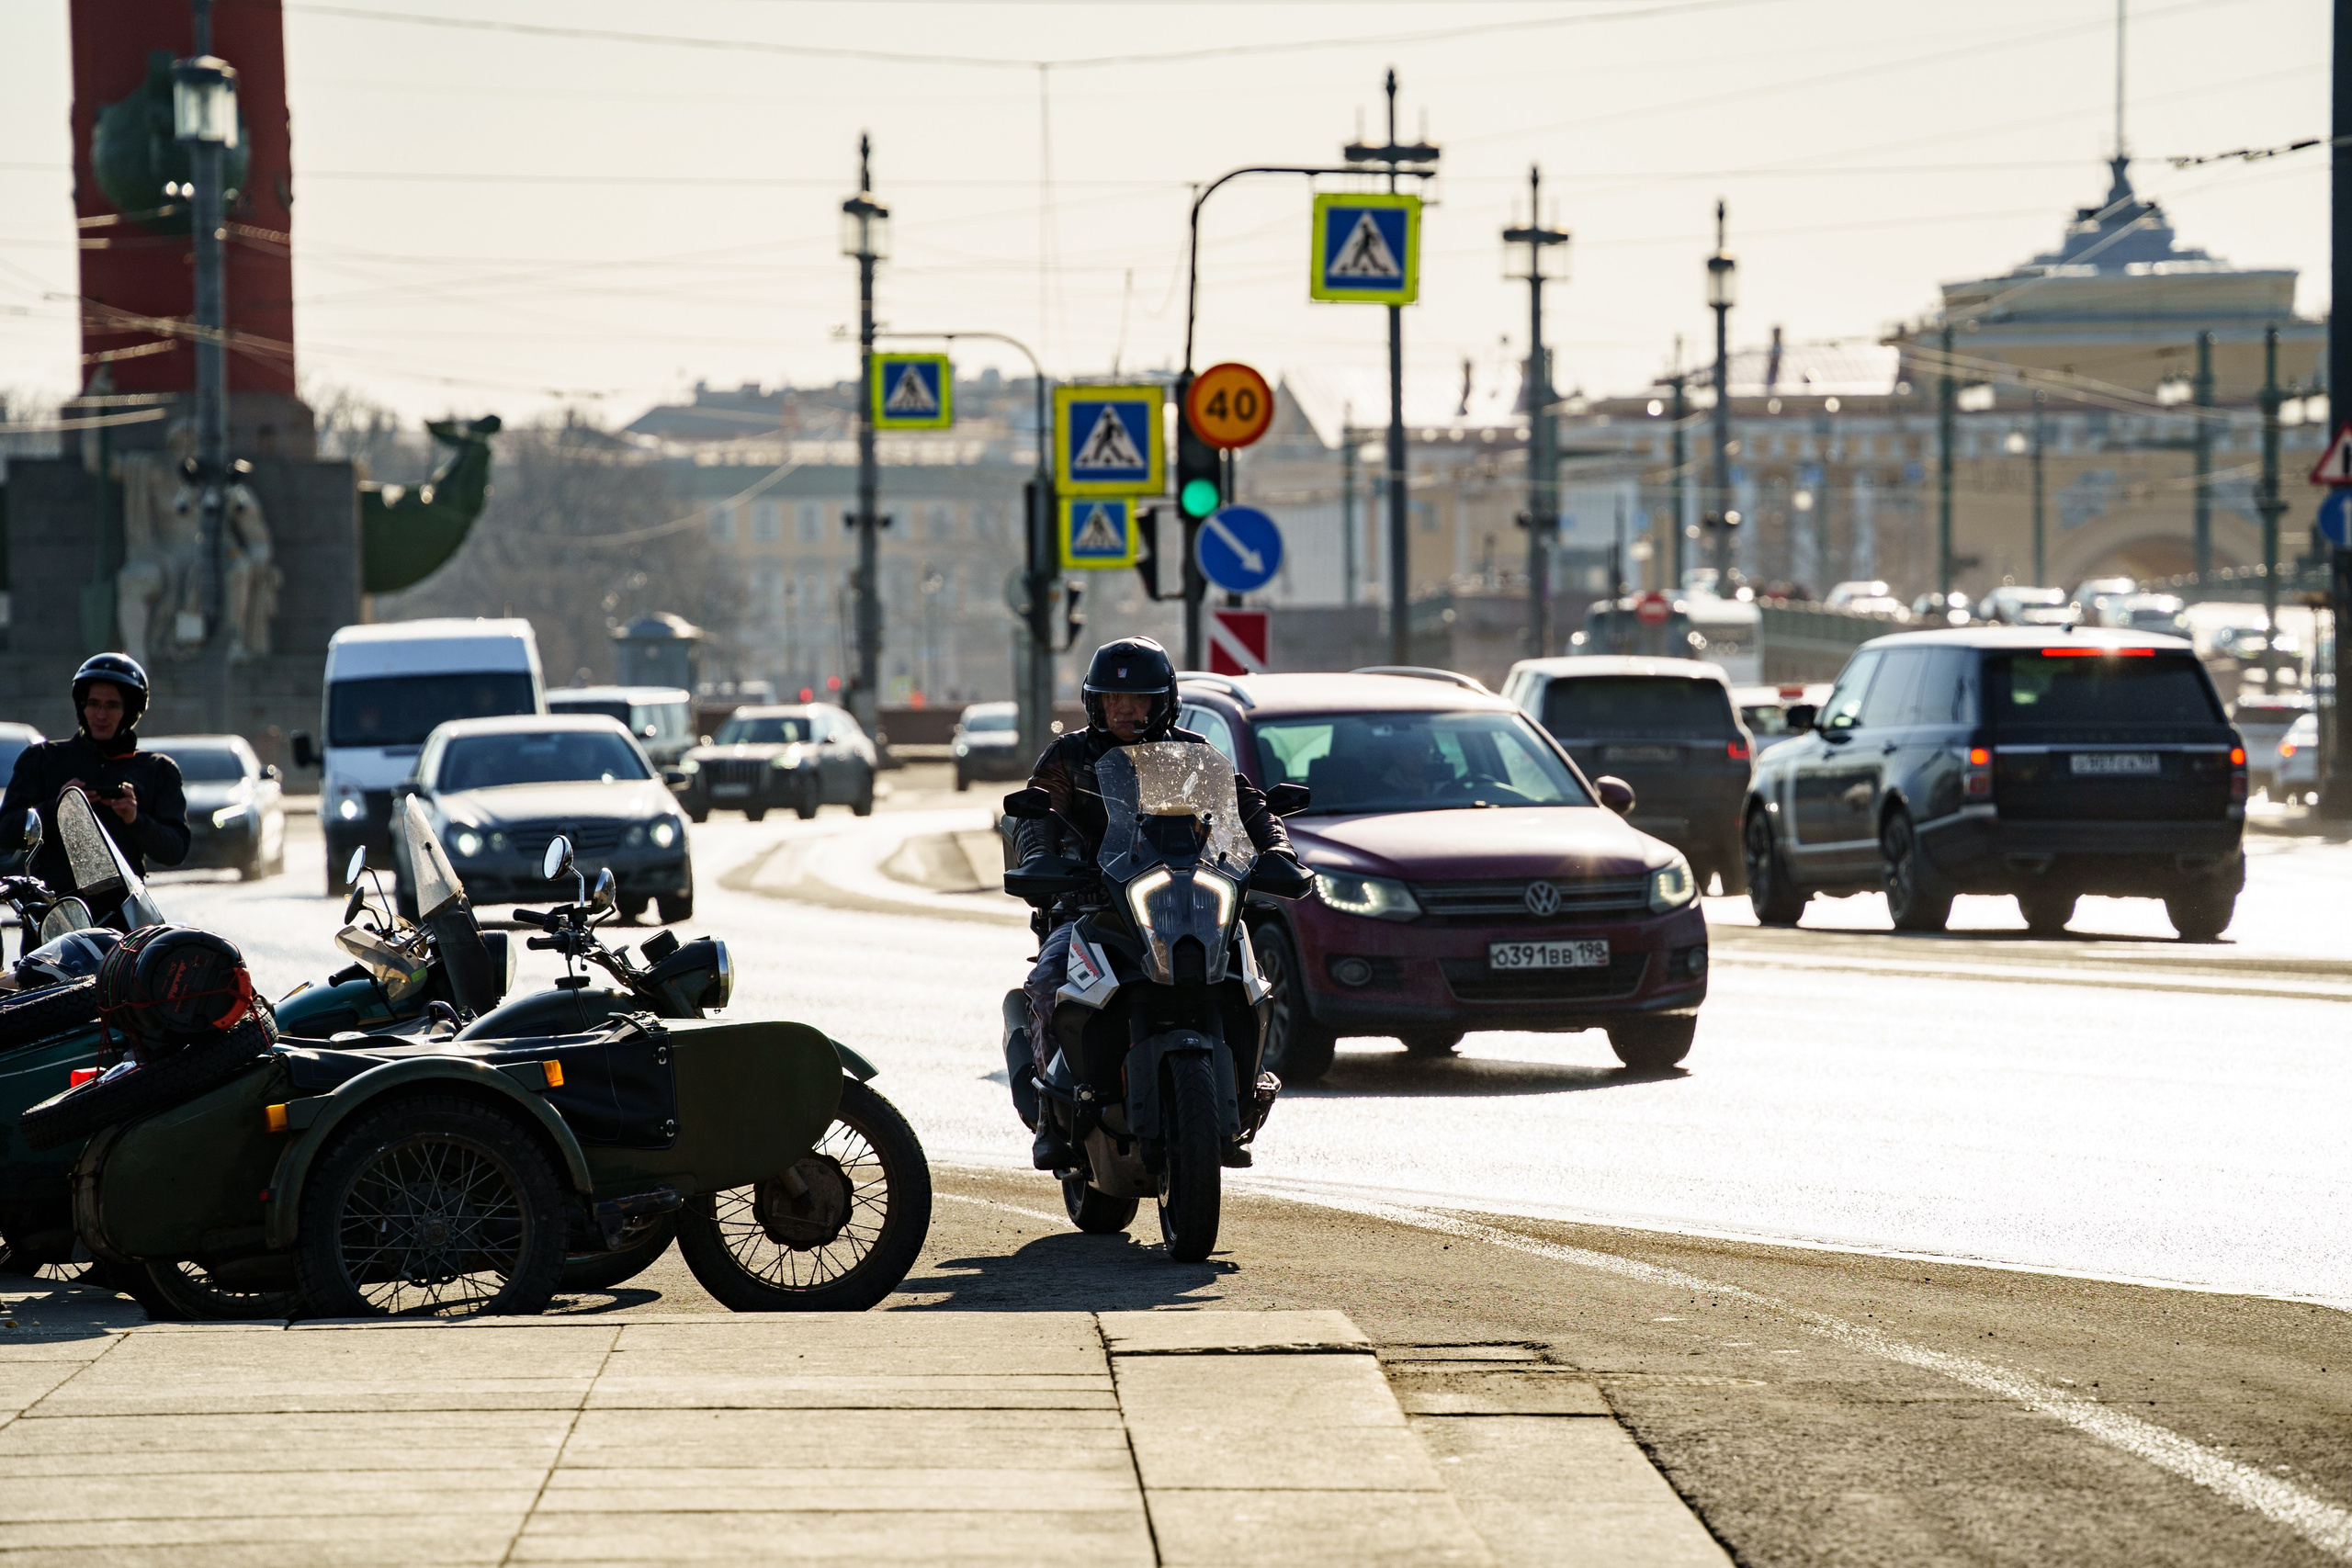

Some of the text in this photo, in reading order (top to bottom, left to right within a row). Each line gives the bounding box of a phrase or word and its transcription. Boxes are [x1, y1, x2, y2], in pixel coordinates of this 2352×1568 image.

[1204, 389, 1257, 421] 40
[1525, 881, 1560, 916] VW
[1071, 942, 1100, 977] SUPER
